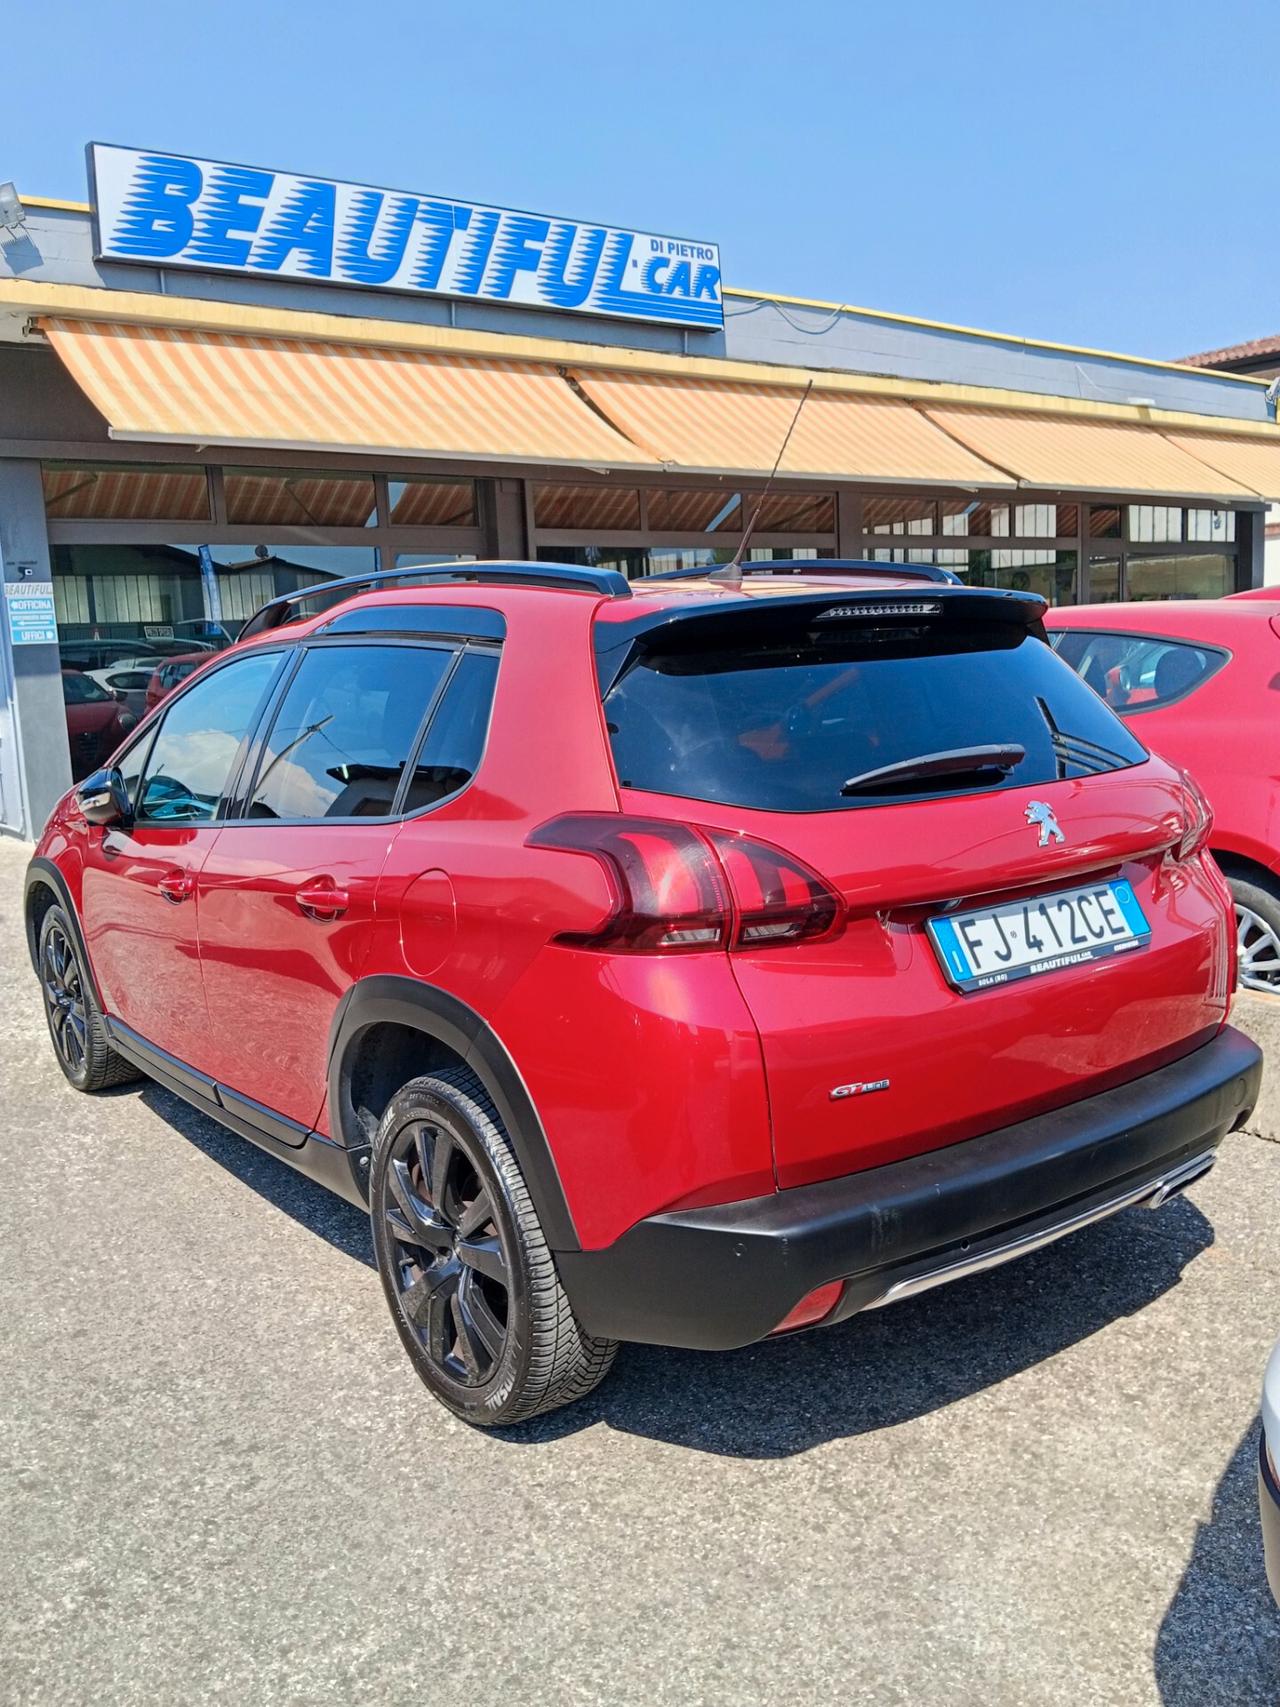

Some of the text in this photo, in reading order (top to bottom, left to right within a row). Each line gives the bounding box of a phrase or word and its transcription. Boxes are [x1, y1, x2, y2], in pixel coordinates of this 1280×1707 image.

[105, 156, 636, 313] BEAUTIFUL
[650, 238, 715, 261] DI PIETRO
